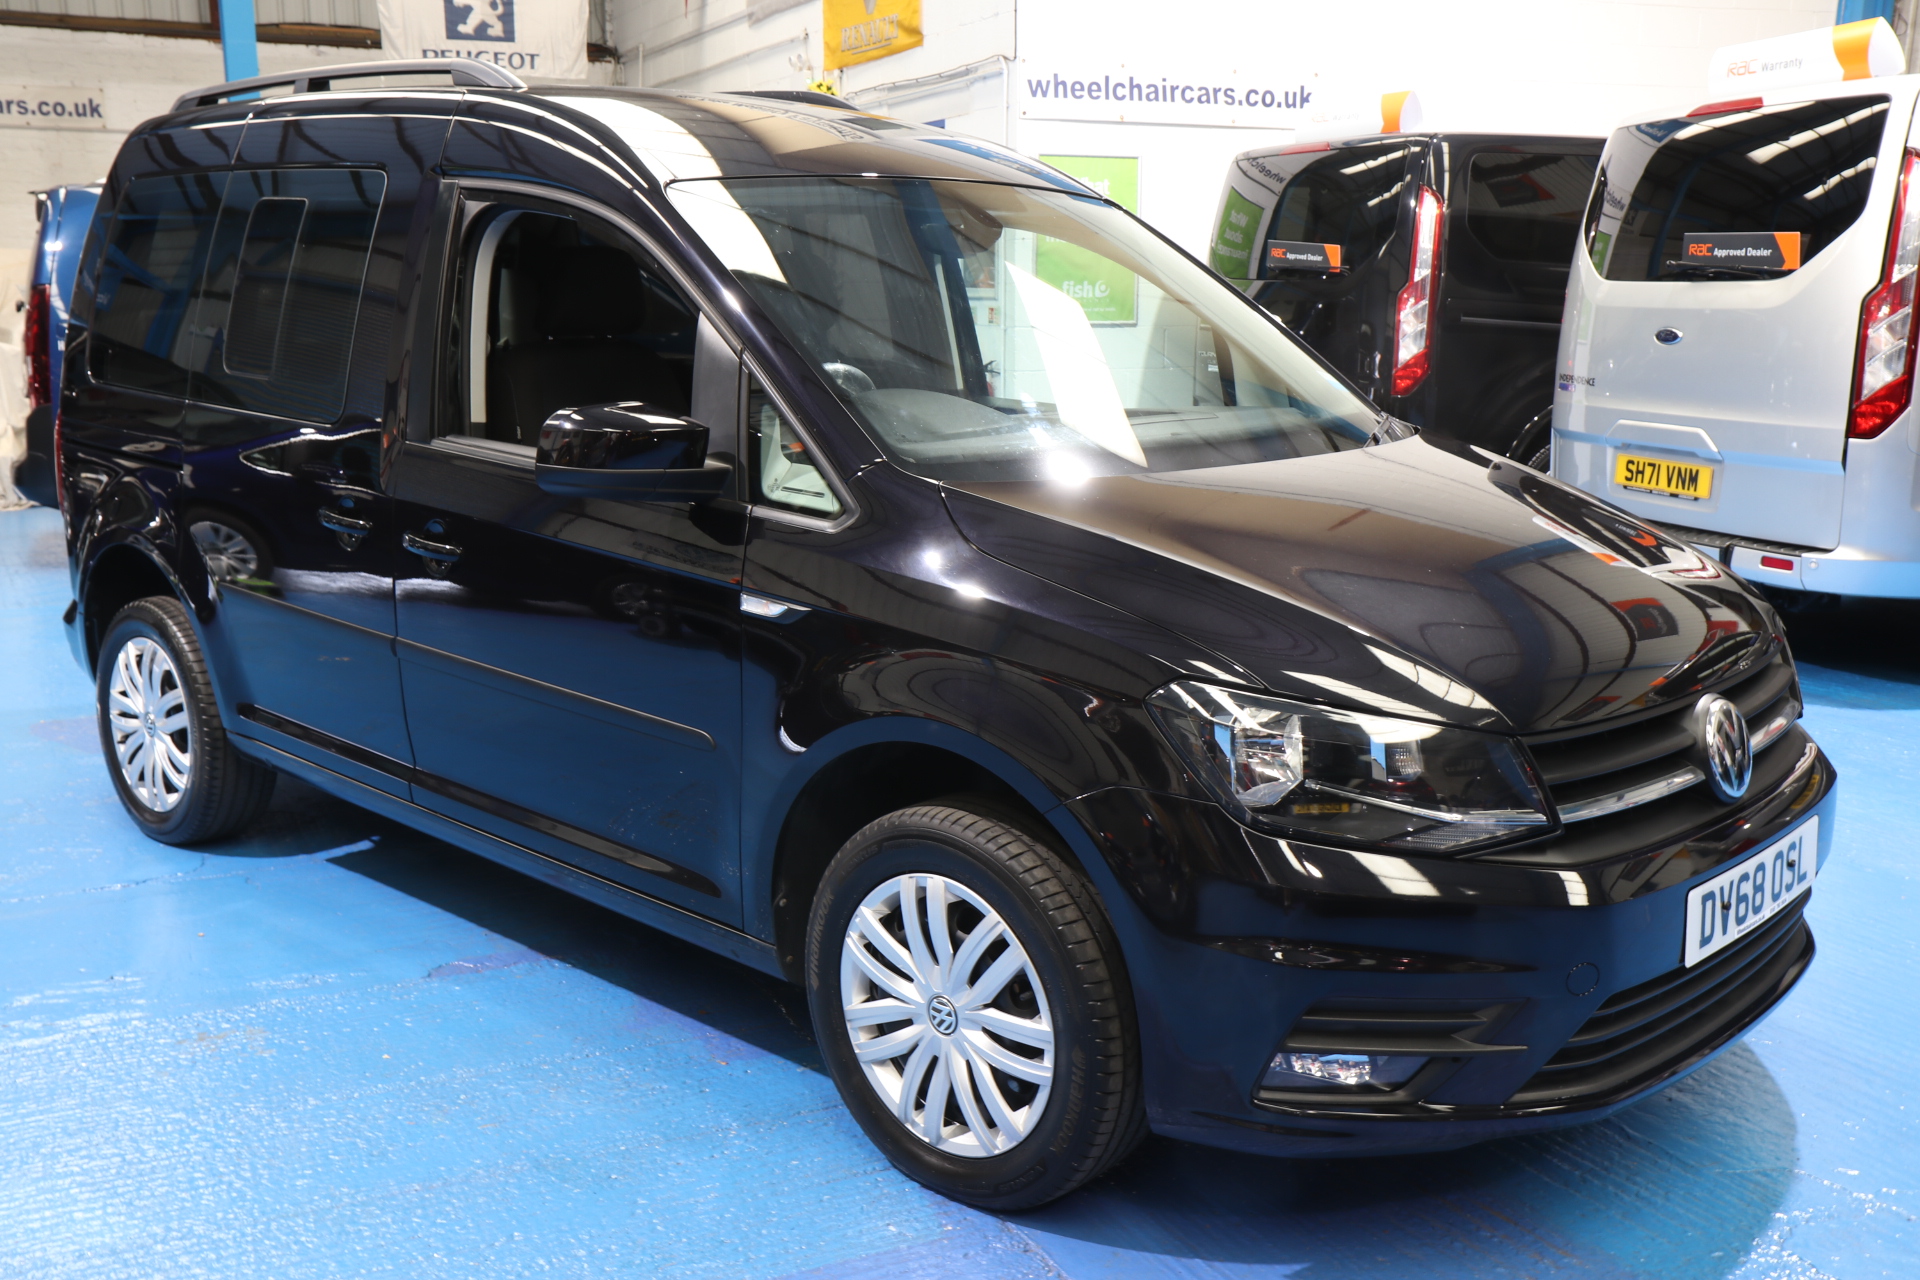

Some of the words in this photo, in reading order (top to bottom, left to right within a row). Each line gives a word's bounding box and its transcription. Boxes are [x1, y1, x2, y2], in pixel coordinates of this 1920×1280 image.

[841, 13, 899, 52] RENAULT
[1761, 58, 1803, 73] Warranty
[1027, 73, 1312, 109] wheelchaircars.co.uk
[0, 98, 103, 118] rs.co.uk
[1287, 252, 1307, 261] Approved
[1307, 253, 1323, 262] Dealer
[1713, 248, 1746, 258] Approved
[1747, 247, 1772, 257] Dealer
[1062, 281, 1093, 298] fish
[1624, 459, 1661, 486] SH71
[1666, 464, 1700, 492] VNM
[1698, 860, 1766, 950] DV68
[1770, 835, 1808, 903] OSL
